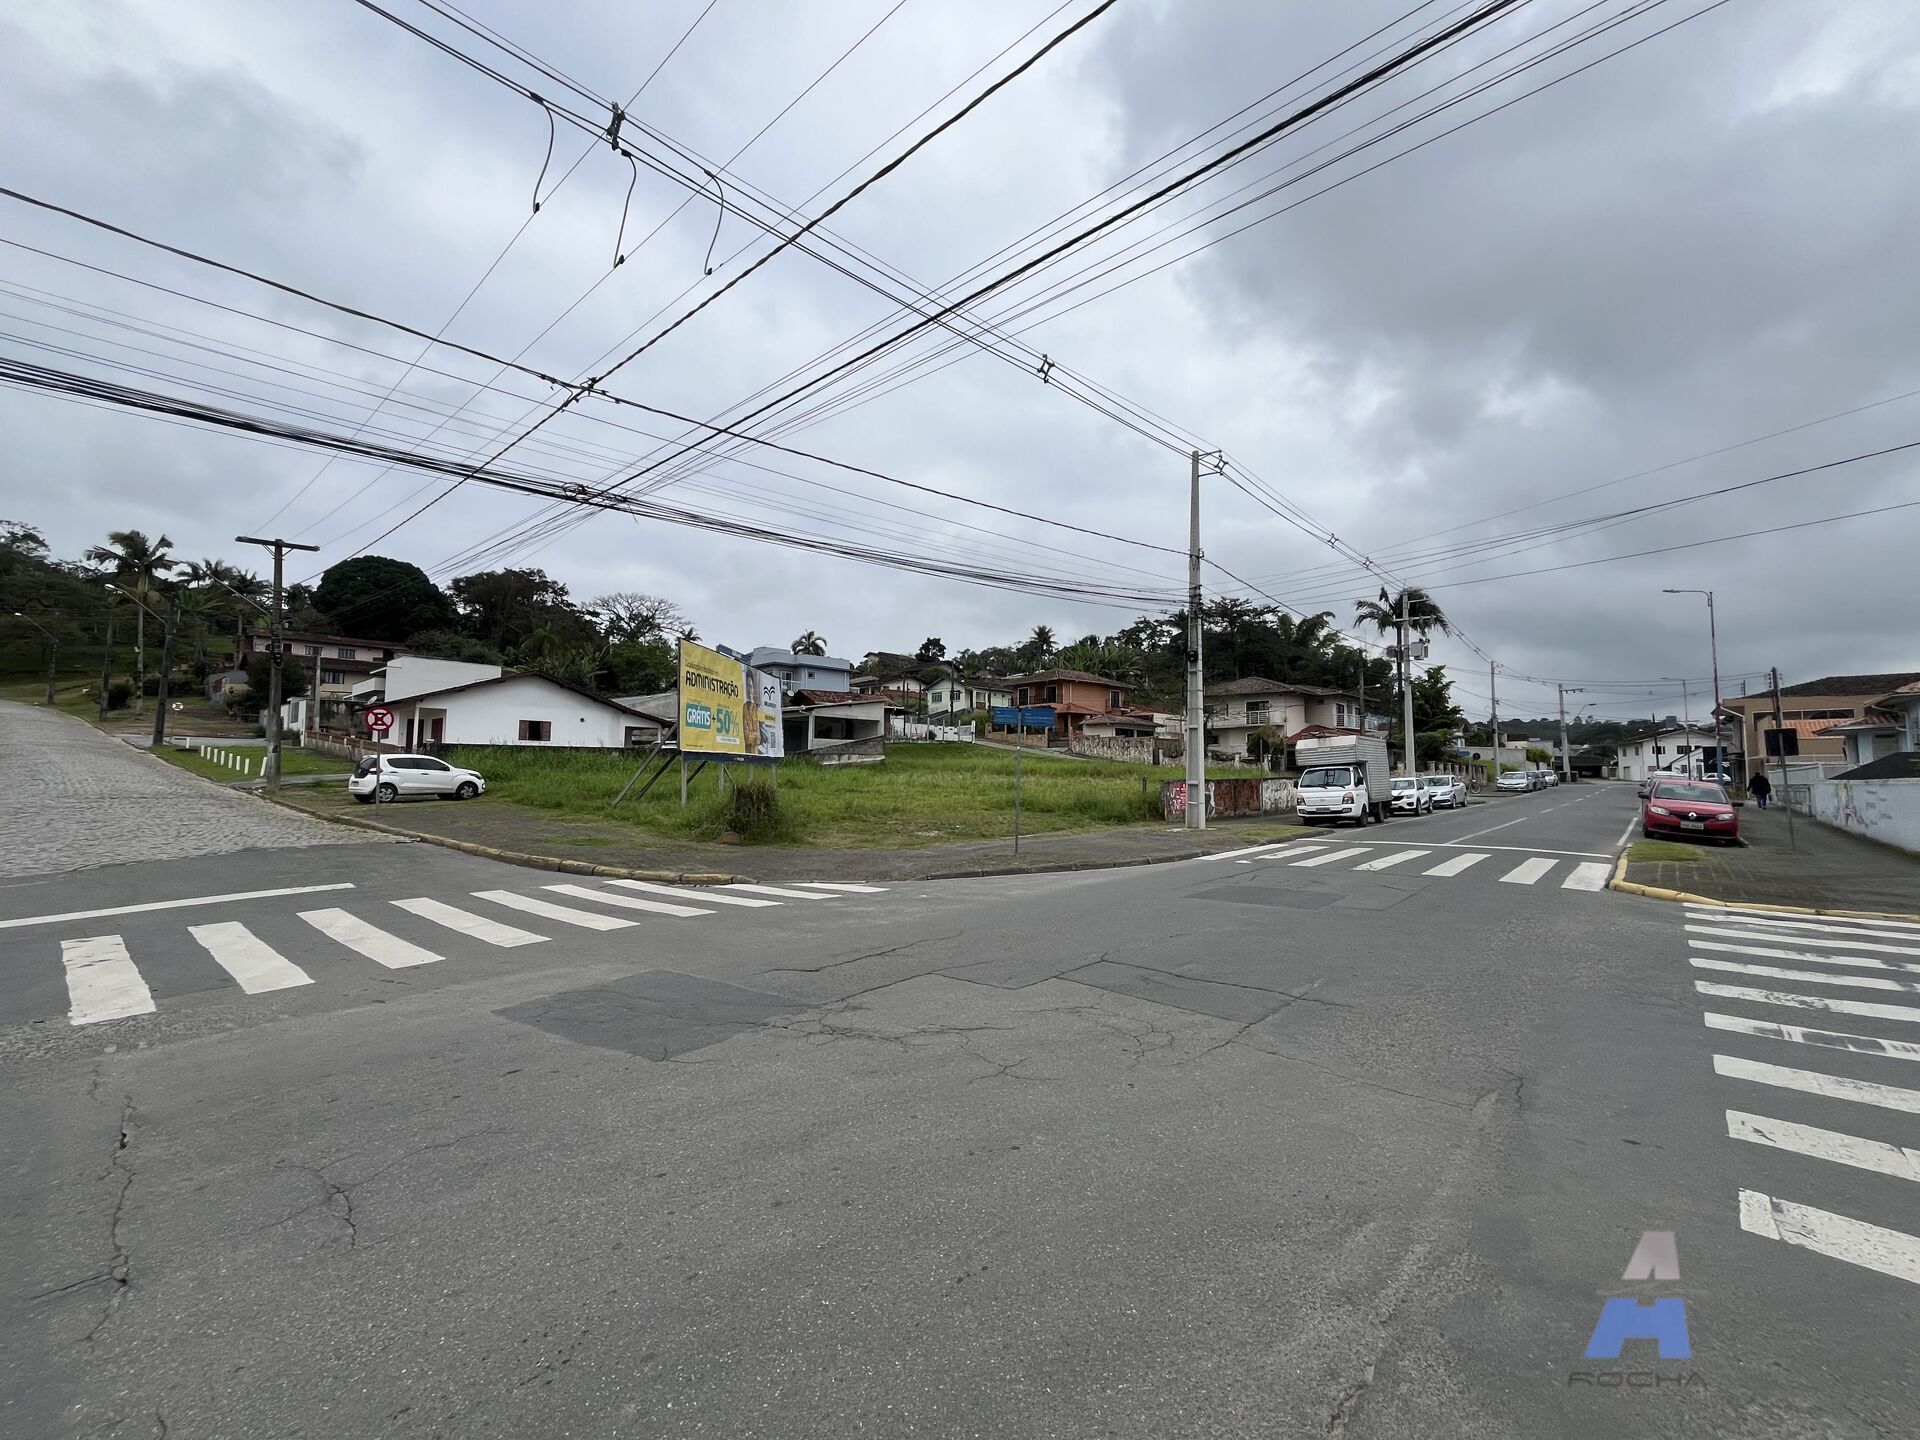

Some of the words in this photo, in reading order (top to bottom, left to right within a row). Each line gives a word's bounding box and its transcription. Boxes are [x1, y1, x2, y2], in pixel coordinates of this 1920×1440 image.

[685, 670, 739, 699] ADMINISTRAÇÃO
[687, 706, 711, 726] GRÁTIS
[716, 707, 740, 736] 50%
